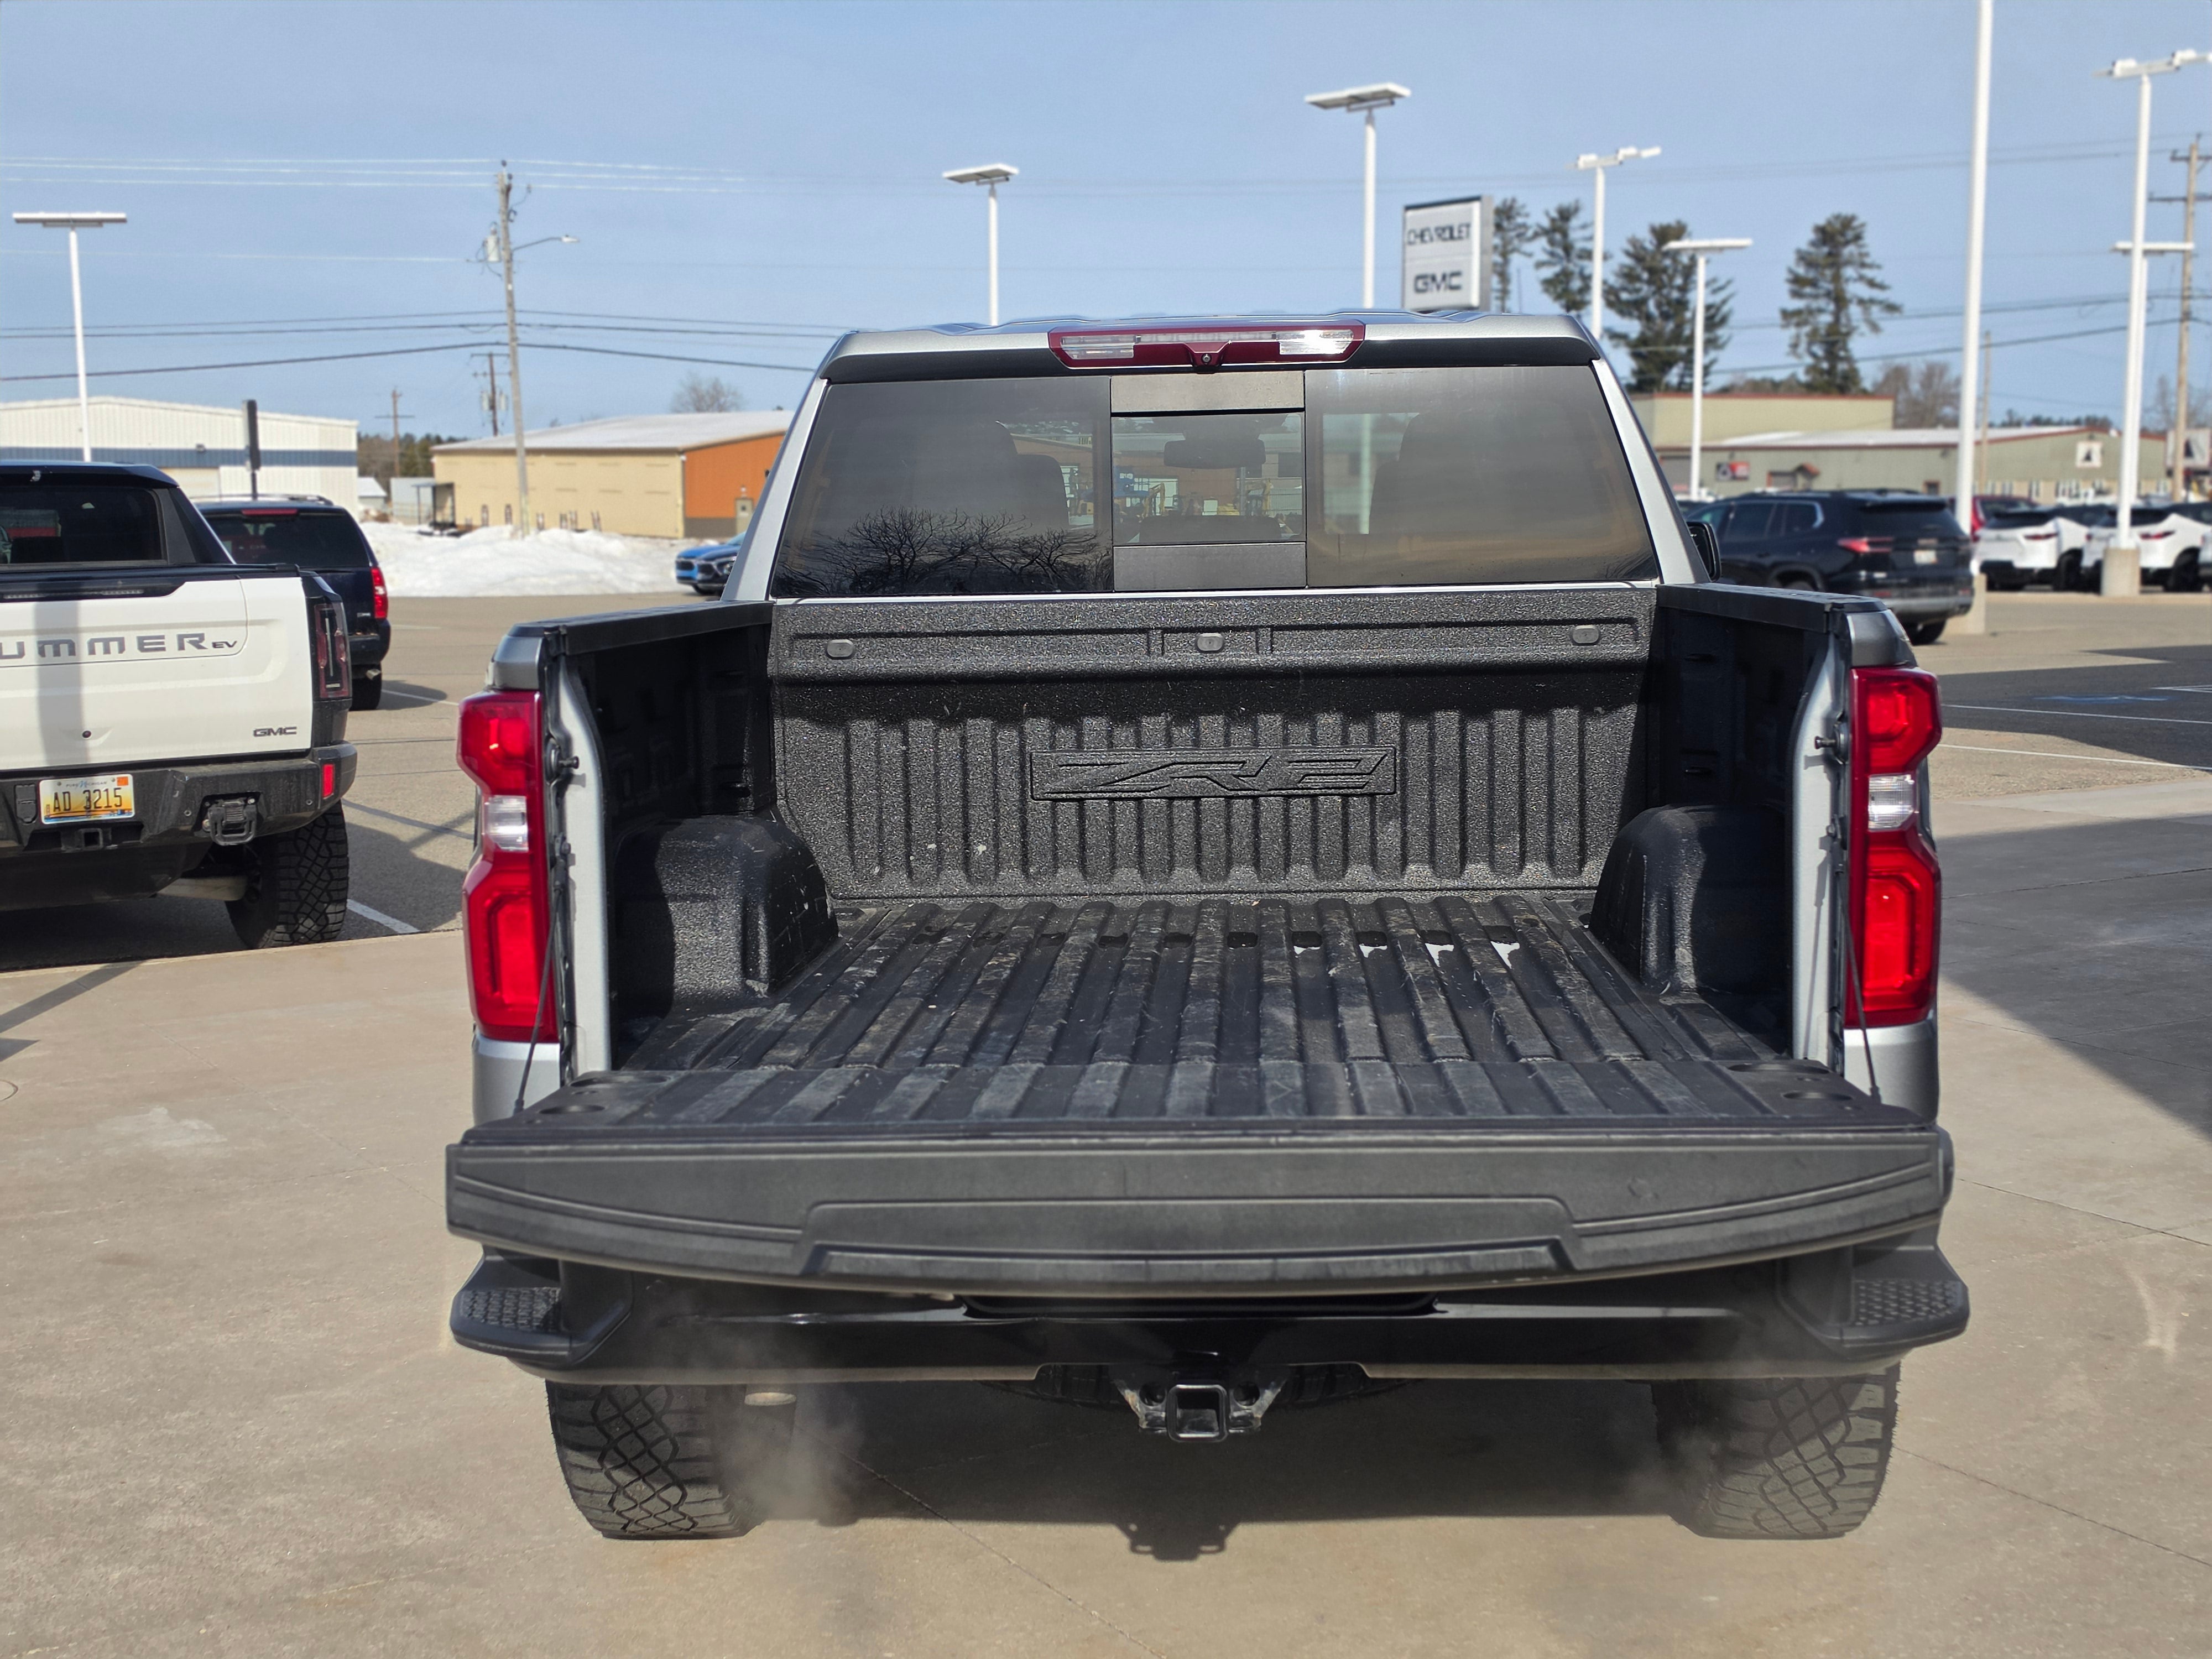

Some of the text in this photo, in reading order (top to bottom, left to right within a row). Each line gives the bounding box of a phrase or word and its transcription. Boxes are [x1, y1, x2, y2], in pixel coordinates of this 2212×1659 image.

[1407, 223, 1471, 245] CHEVROLET
[1414, 270, 1463, 294] GMC
[253, 727, 297, 737] GMC
[53, 787, 123, 812] AD 3215
